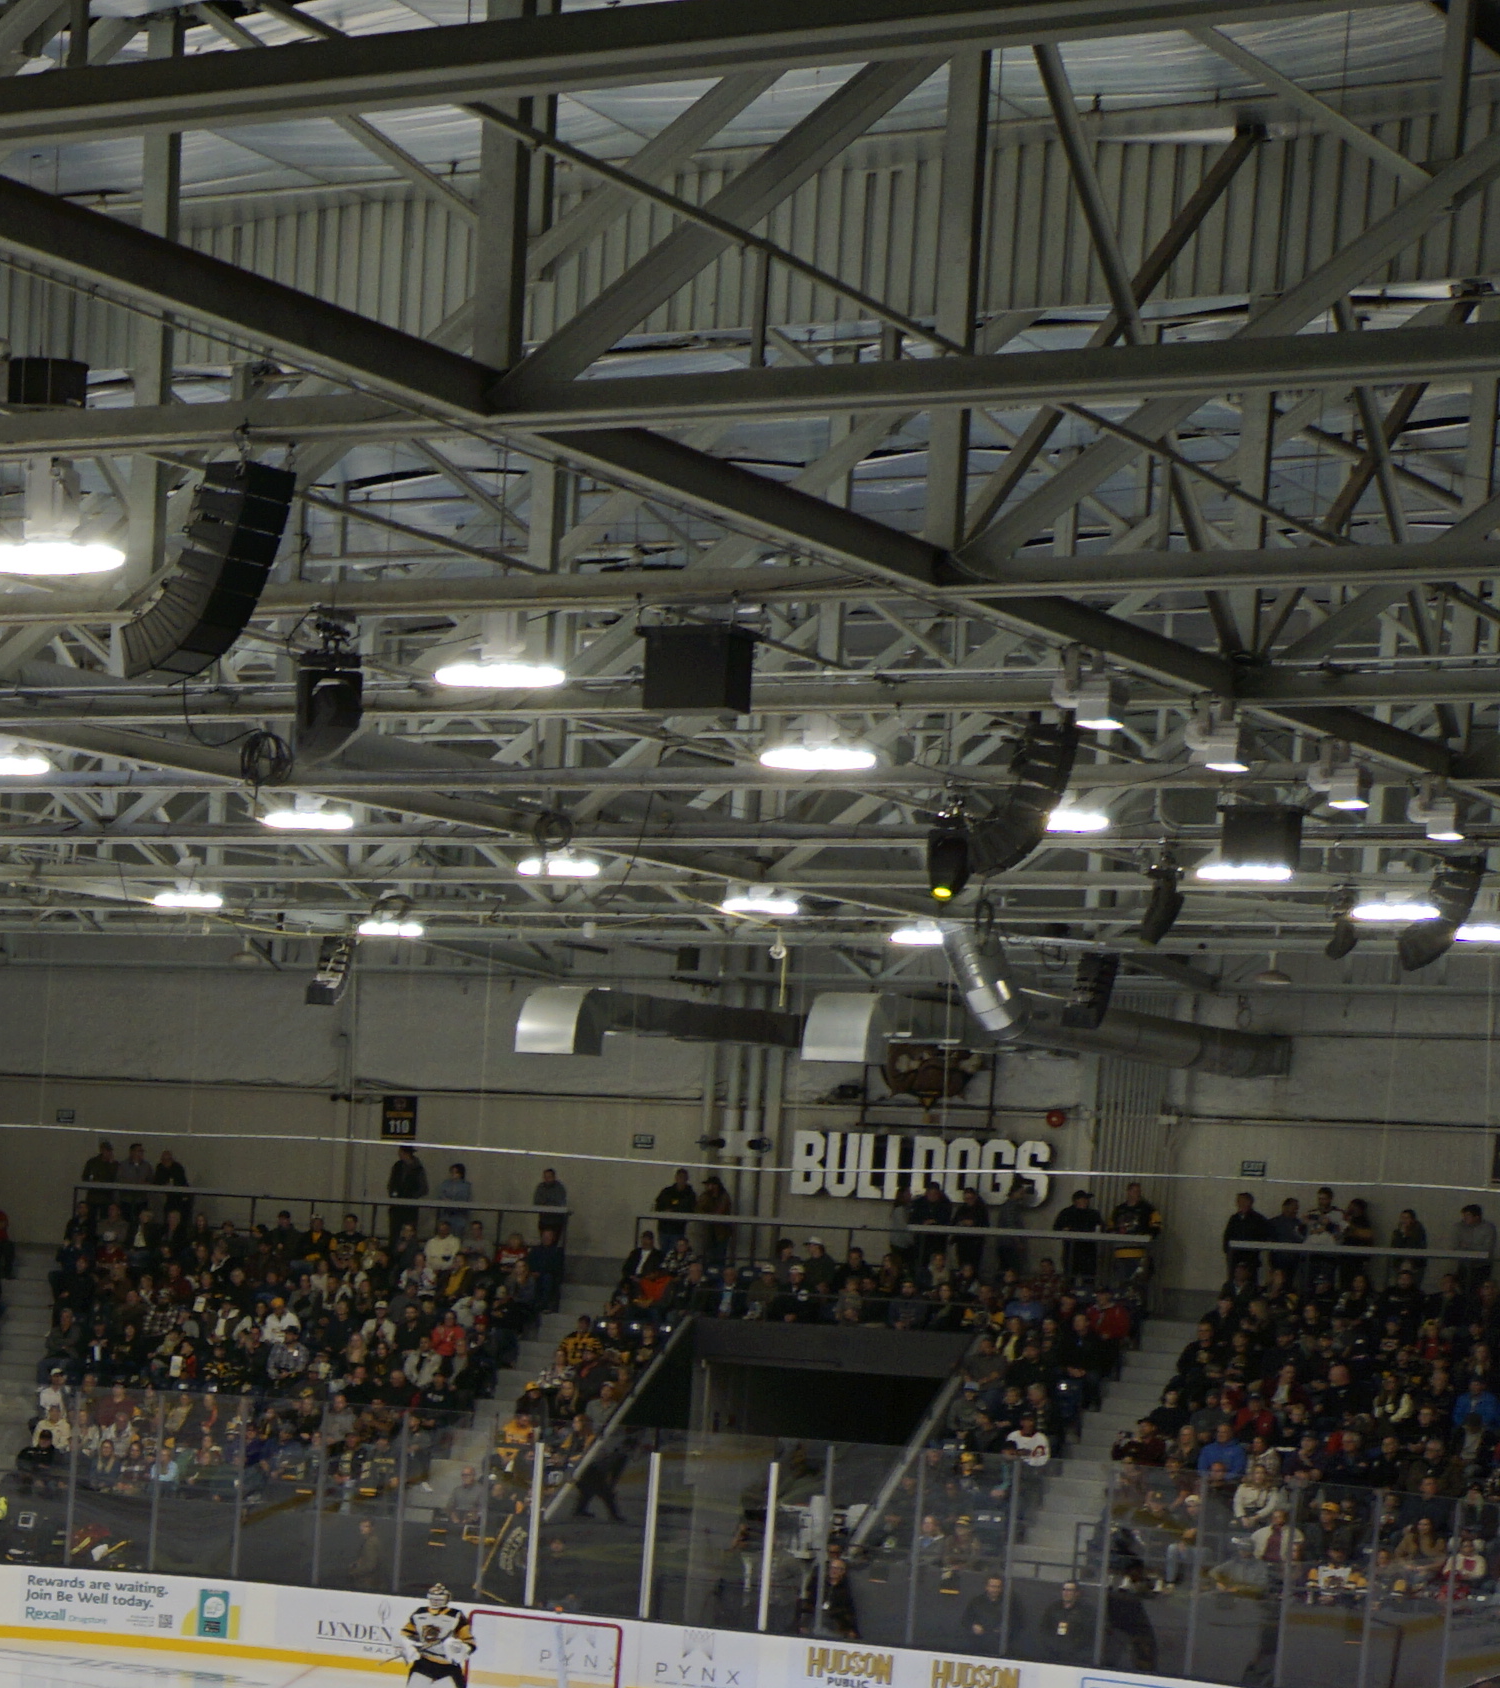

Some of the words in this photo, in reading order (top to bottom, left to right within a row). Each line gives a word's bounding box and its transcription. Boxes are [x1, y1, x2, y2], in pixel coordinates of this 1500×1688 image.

[790, 1129, 1054, 1208] BULLDOGS
[27, 1574, 86, 1590] Rewards
[88, 1581, 111, 1591] are
[114, 1581, 169, 1598] waiting.
[25, 1589, 53, 1602] Join
[56, 1591, 74, 1602] Be
[77, 1592, 109, 1605] Well
[111, 1595, 155, 1611] today.
[25, 1606, 67, 1622] Rexall
[316, 1620, 394, 1643] LYNDEN
[655, 1661, 741, 1686] PYNX
[805, 1646, 894, 1686] HUDSON
